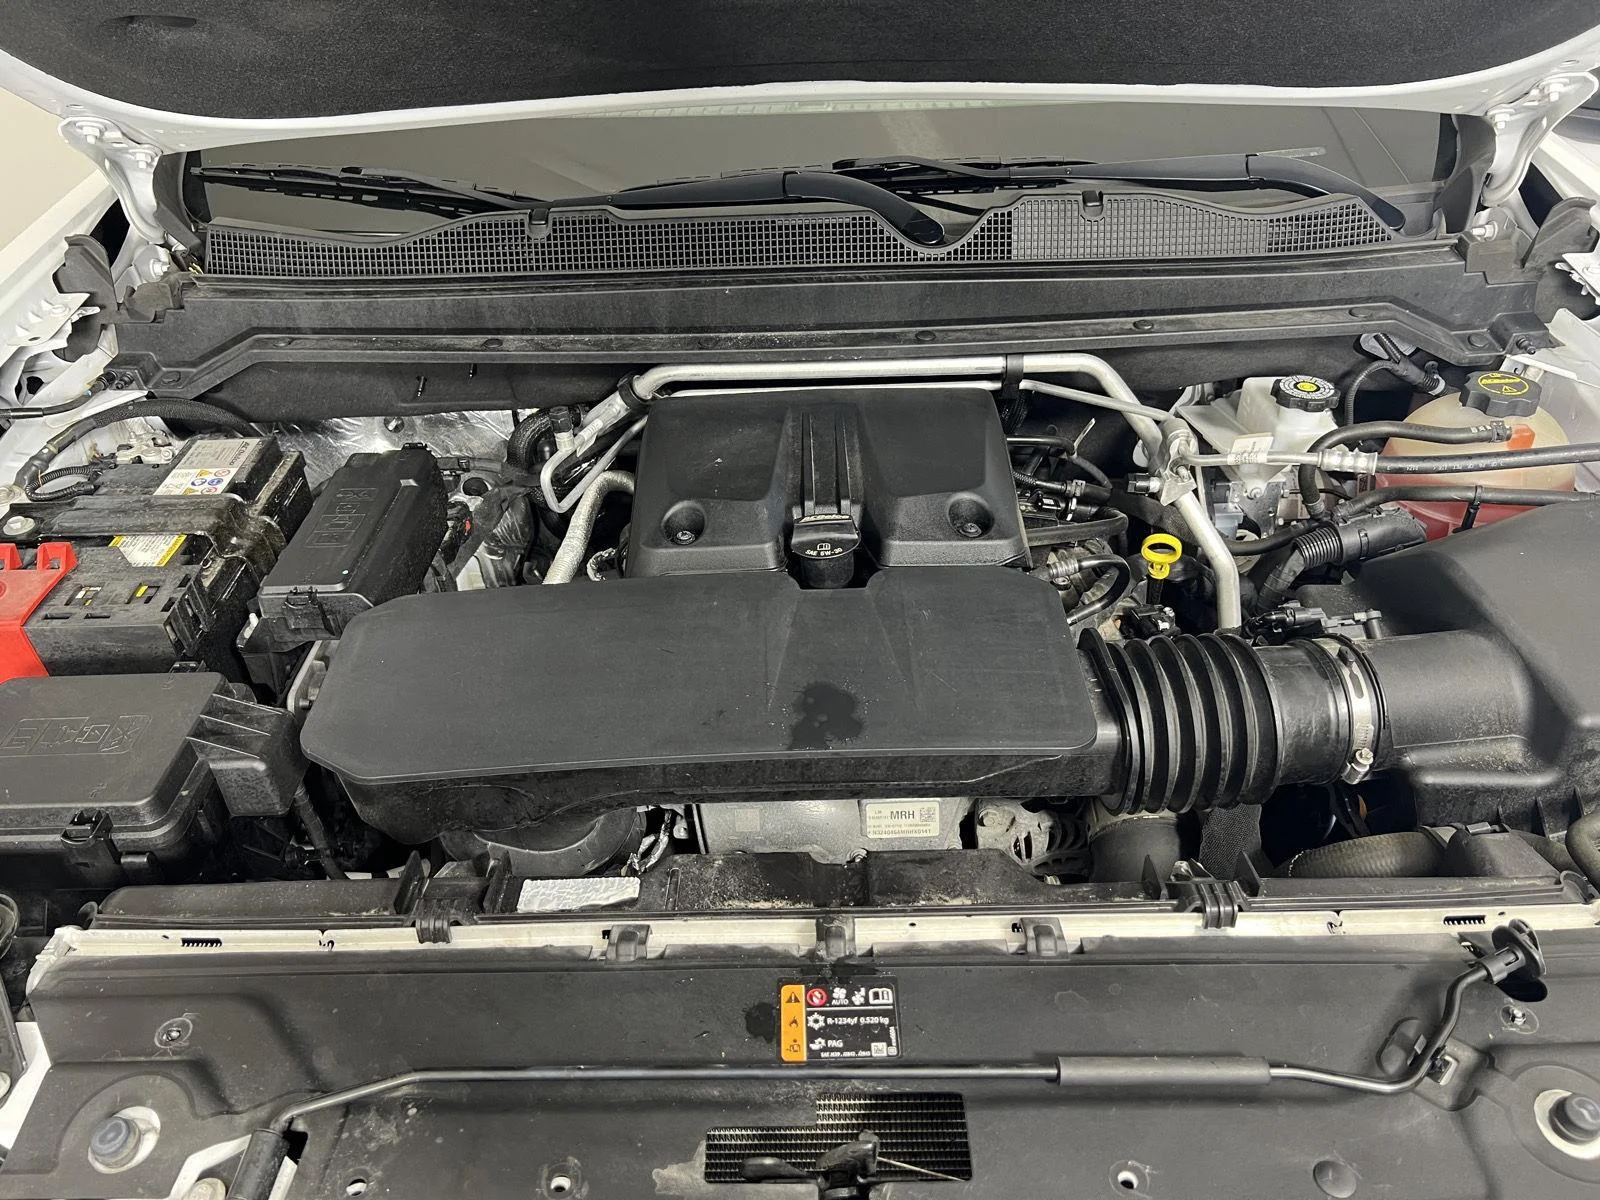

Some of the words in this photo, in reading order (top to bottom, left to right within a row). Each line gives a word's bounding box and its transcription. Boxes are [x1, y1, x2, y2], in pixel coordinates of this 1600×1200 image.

[890, 810, 915, 820] MRH
[831, 998, 849, 1006] AUTO
[826, 1016, 858, 1026] R-1234yf
[859, 1016, 879, 1025] 0.520
[879, 1015, 890, 1026] kg
[827, 1039, 844, 1048] PAG
